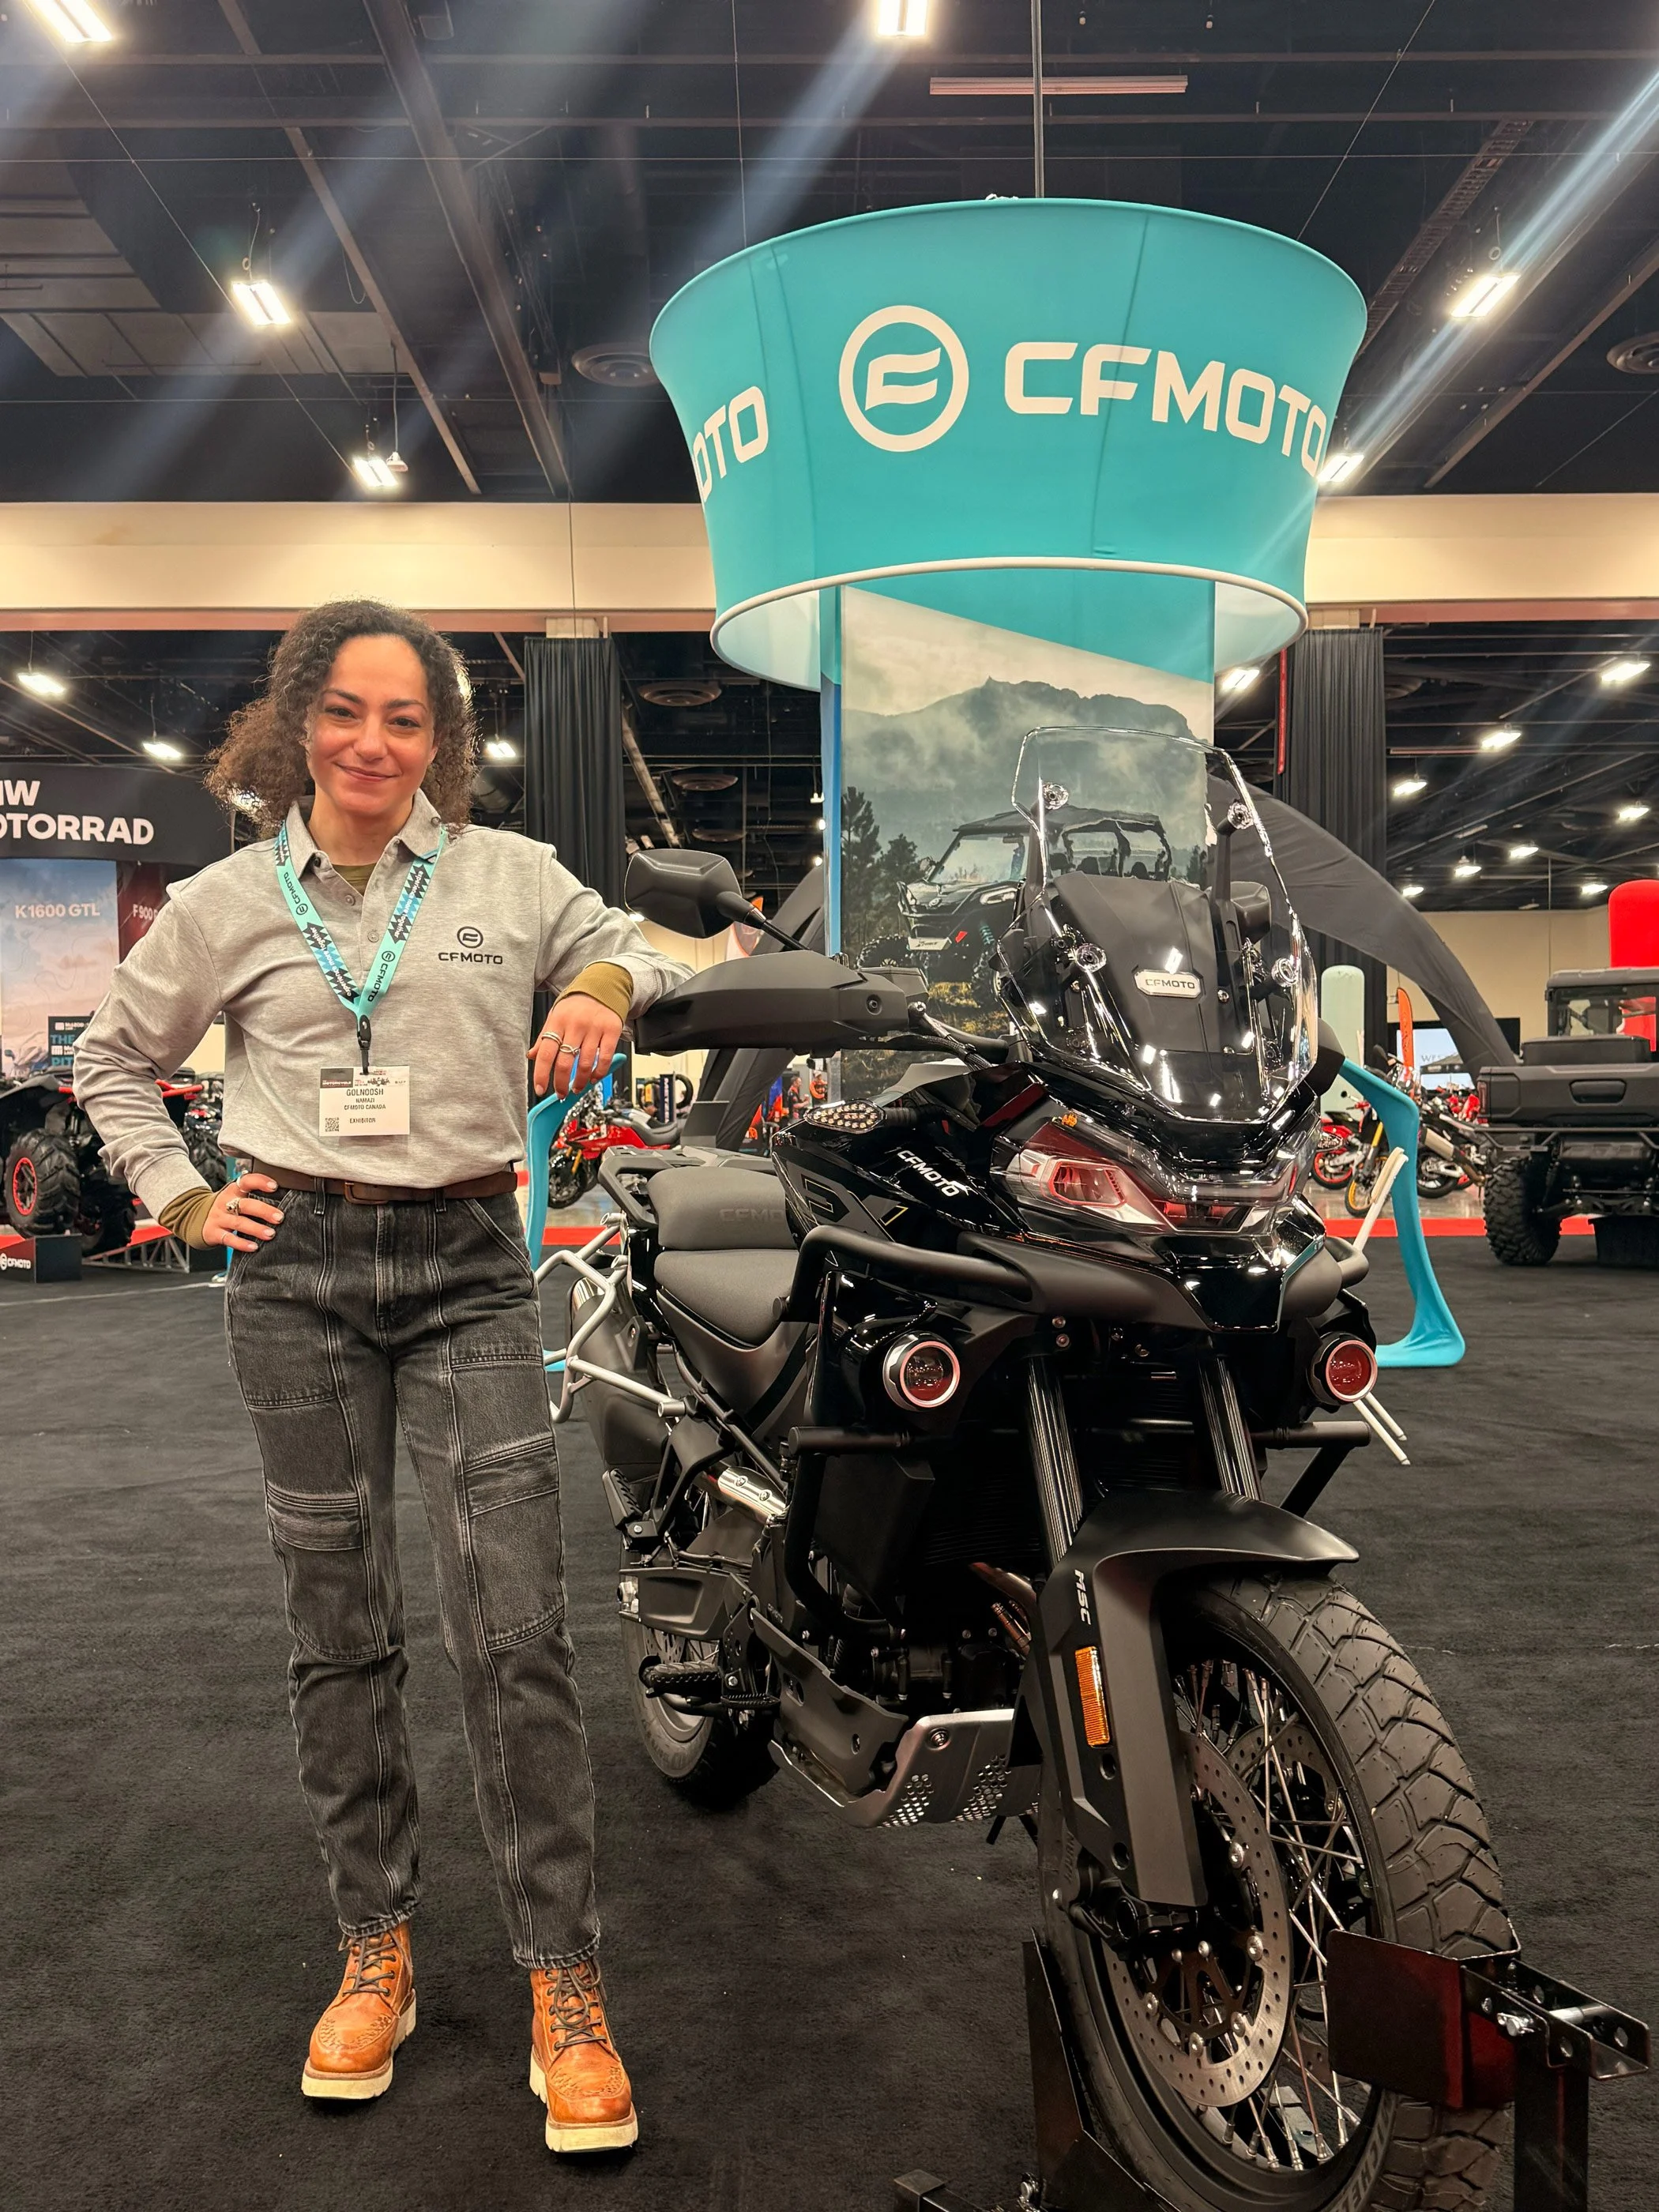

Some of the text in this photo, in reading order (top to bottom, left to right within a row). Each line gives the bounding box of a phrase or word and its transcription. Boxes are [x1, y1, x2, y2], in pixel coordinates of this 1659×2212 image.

[1005, 341, 1326, 477] CFMOTO
[692, 386, 769, 504] OTO
[284, 871, 302, 905] CFMOTO
[68, 903, 100, 917] GTL
[438, 952, 503, 965] CFMOTO
[367, 963, 389, 1003] CFMOTO
[1146, 979, 1195, 989] CFMOTO
[346, 1088, 384, 1097] GOLNOOSH
[897, 1149, 961, 1198] CFMOTO
